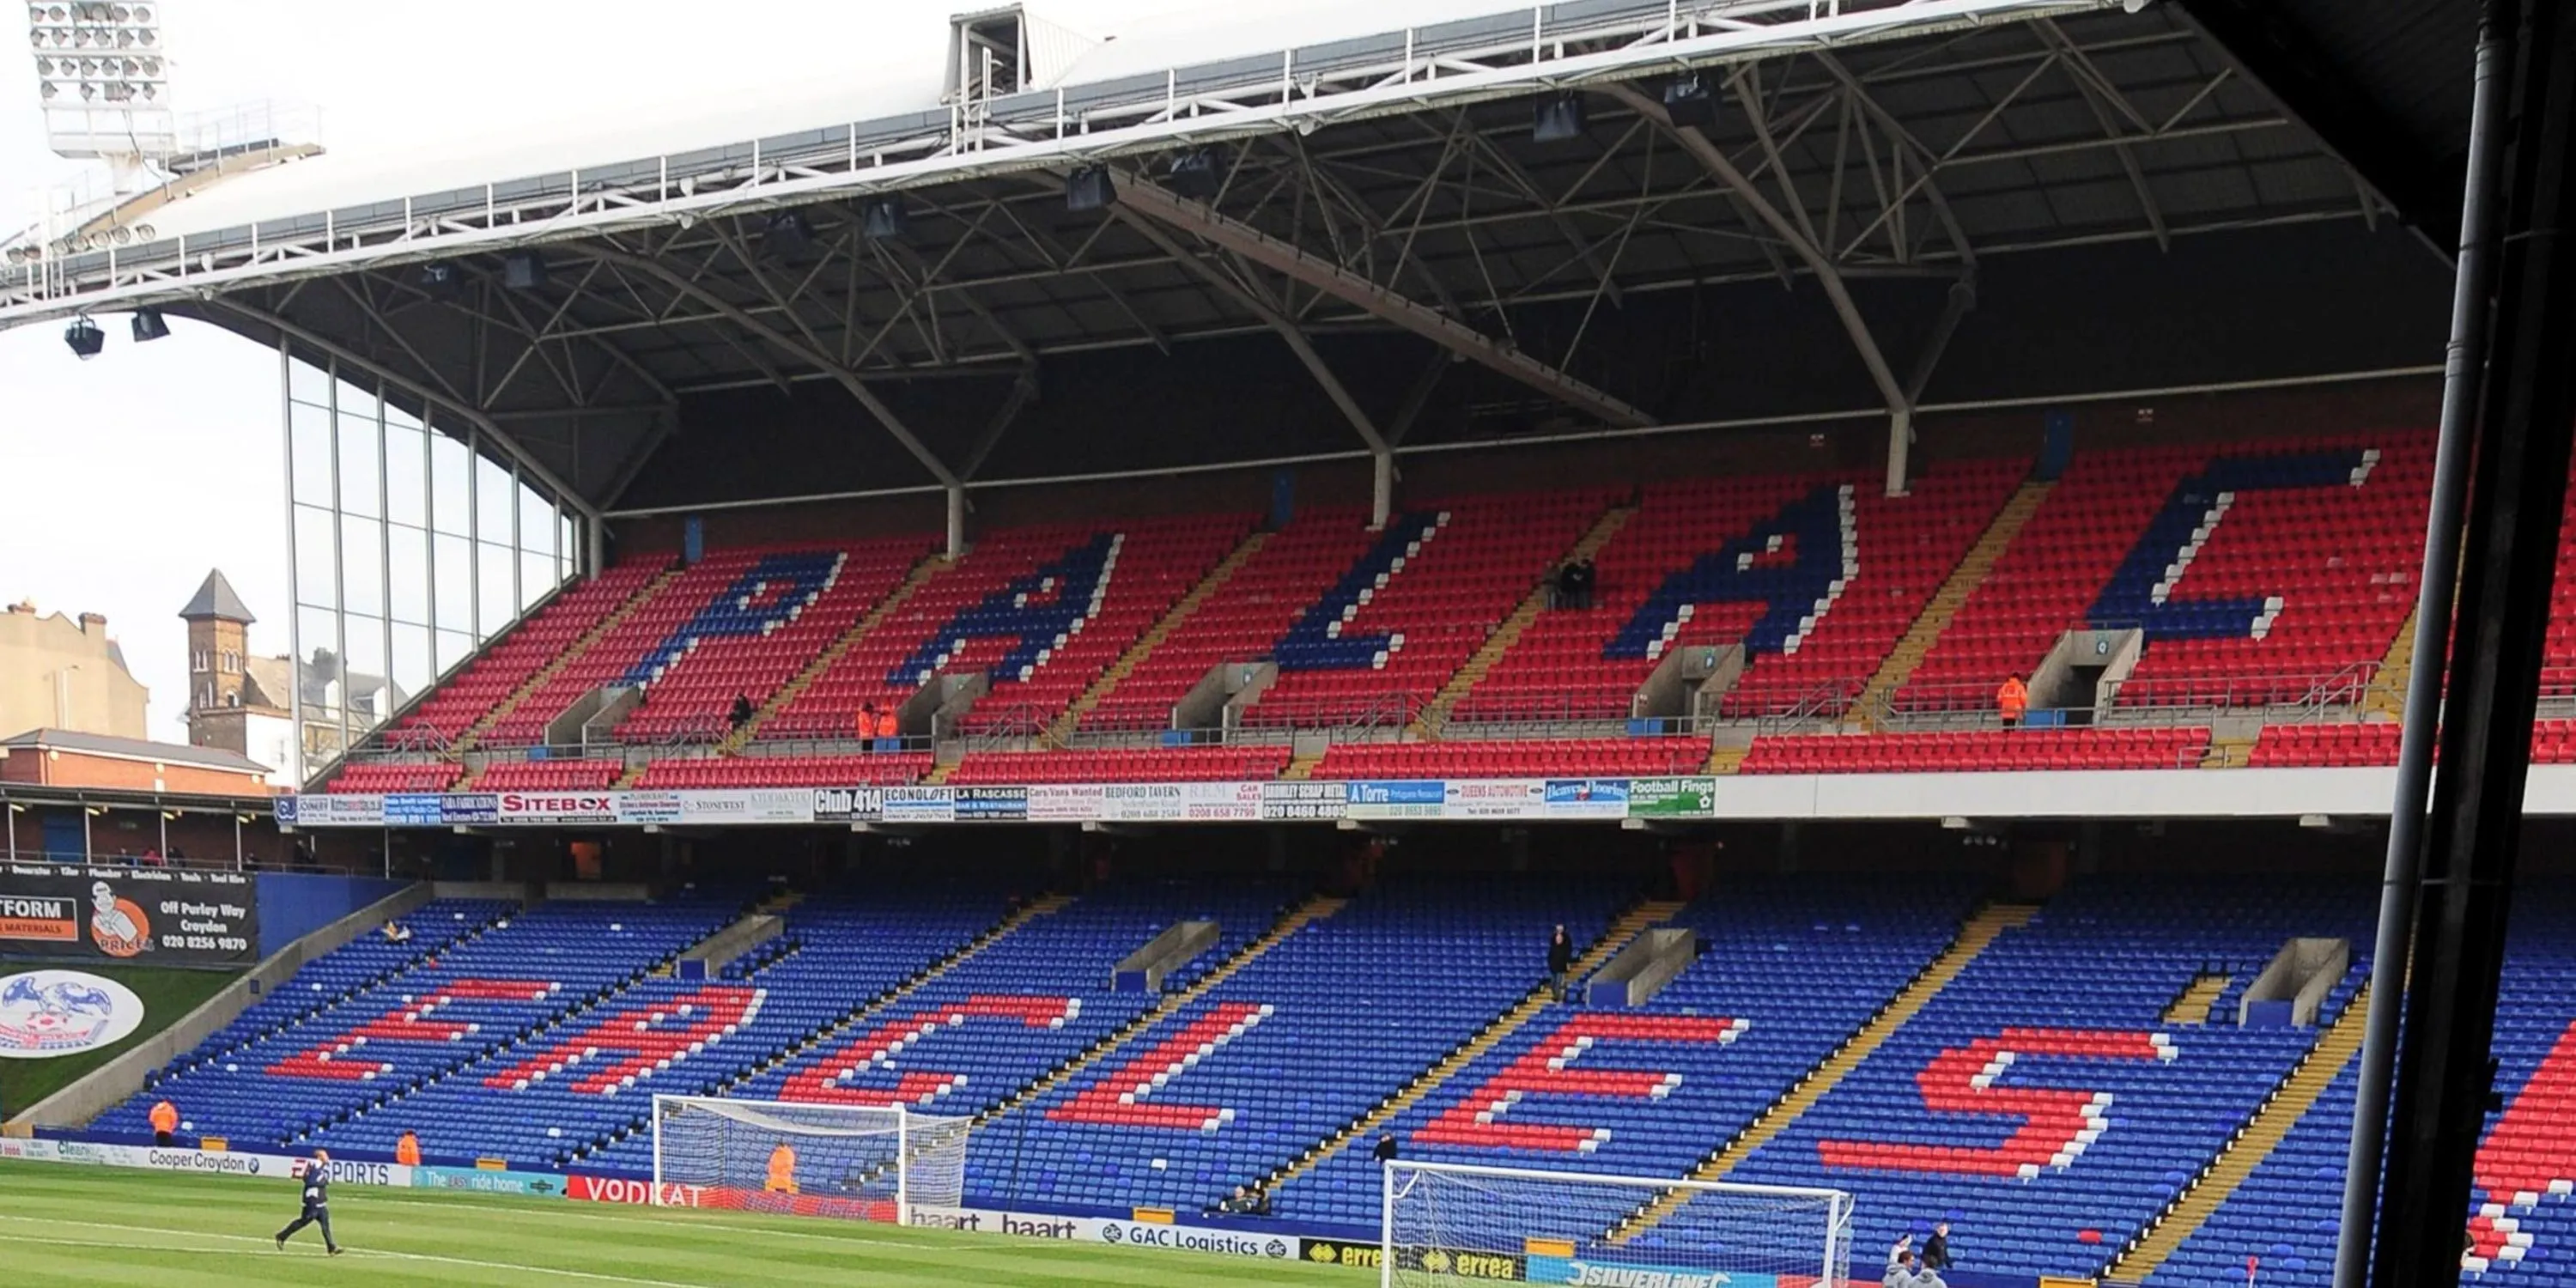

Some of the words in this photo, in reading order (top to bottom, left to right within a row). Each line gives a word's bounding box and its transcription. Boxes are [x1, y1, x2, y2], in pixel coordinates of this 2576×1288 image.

[957, 789, 971, 799] LA
[974, 788, 1026, 799] RASCASSE
[1105, 787, 1146, 799] BEDFORD
[1149, 785, 1181, 798] TAVERN
[1350, 787, 1360, 803] A
[1361, 785, 1389, 802] Torre
[1631, 781, 1679, 793] Football
[1681, 780, 1714, 797] Fings
[503, 794, 611, 812] SITEBOX
[816, 790, 852, 813] Club
[854, 791, 882, 812] 414
[1188, 807, 1211, 817] 0208
[1265, 805, 1284, 818] 020
[161, 902, 179, 915] Off
[181, 902, 218, 920] Purley
[220, 905, 246, 921] Way
[180, 920, 228, 935] Croydon
[162, 935, 185, 948] 020
[187, 936, 216, 950] 8256
[218, 937, 247, 951] 9870
[149, 1150, 192, 1170] Cooper
[195, 1152, 245, 1174] Croydon
[427, 1171, 447, 1187] The
[472, 1173, 492, 1190] ride
[494, 1174, 524, 1193] home
[585, 1176, 706, 1207] VODKAT
[910, 1206, 981, 1231] haart
[1002, 1214, 1077, 1239] haart
[1129, 1226, 1170, 1247] GAC
[1175, 1230, 1258, 1255] Logistics
[1341, 1246, 1393, 1268] erre
[1455, 1253, 1514, 1279] errea
